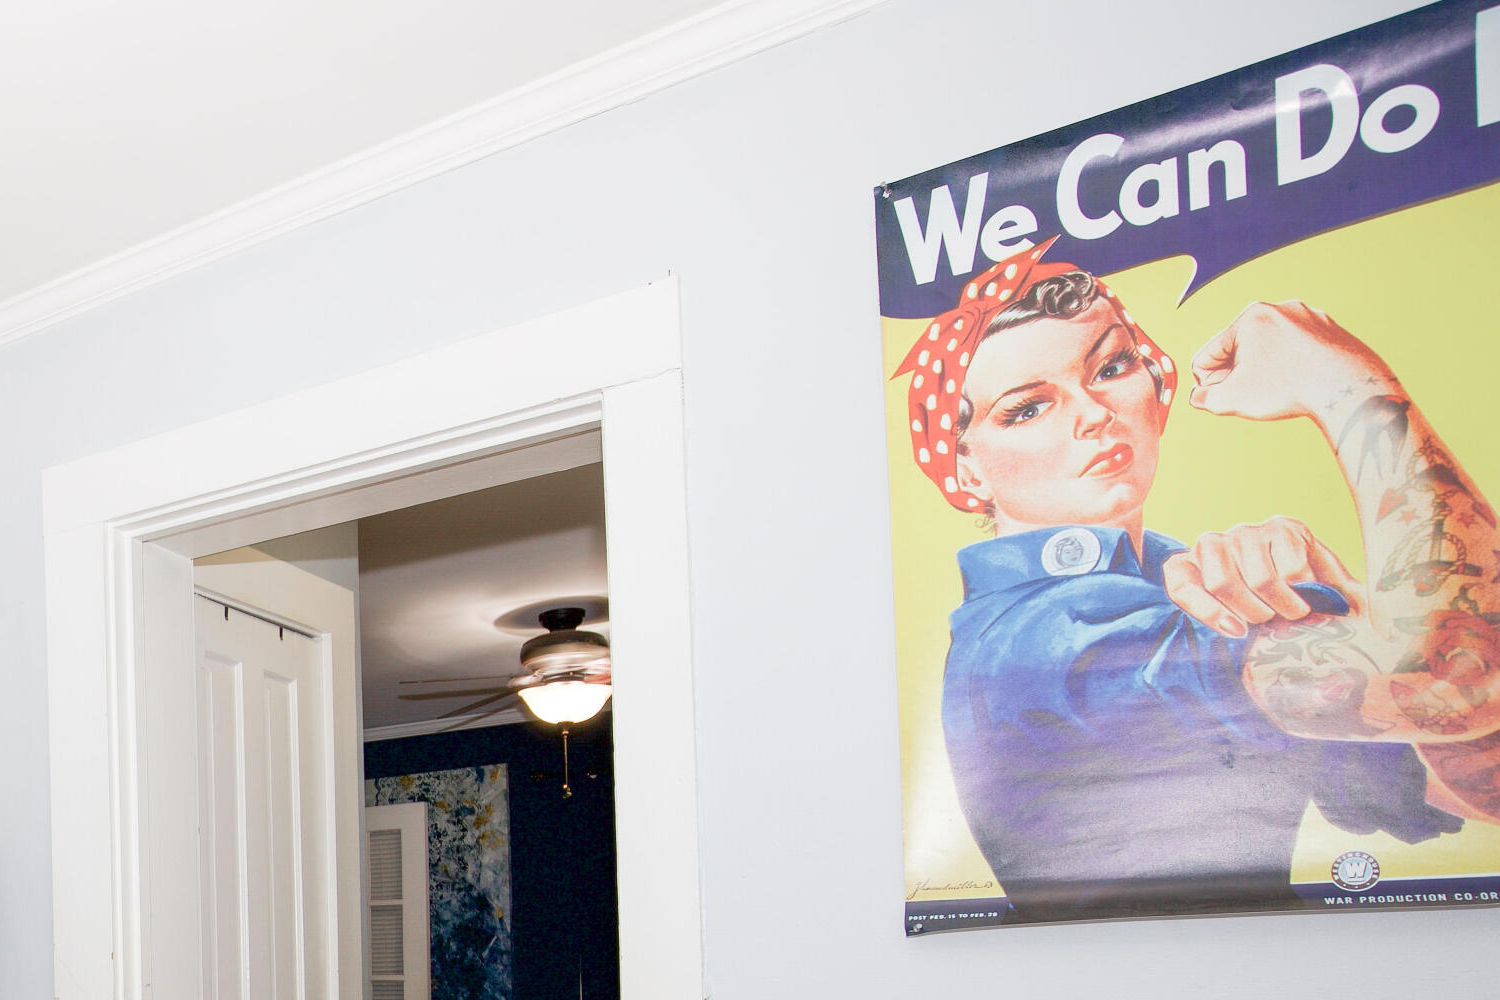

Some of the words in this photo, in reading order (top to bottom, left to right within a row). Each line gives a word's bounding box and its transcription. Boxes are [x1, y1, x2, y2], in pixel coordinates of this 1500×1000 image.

[894, 171, 1038, 285] We
[1056, 134, 1248, 240] Can
[1275, 64, 1440, 186] Do
[1324, 896, 1353, 905] WAR
[1359, 893, 1447, 904] PRODUCTION
[1454, 891, 1500, 901] CO-OR
